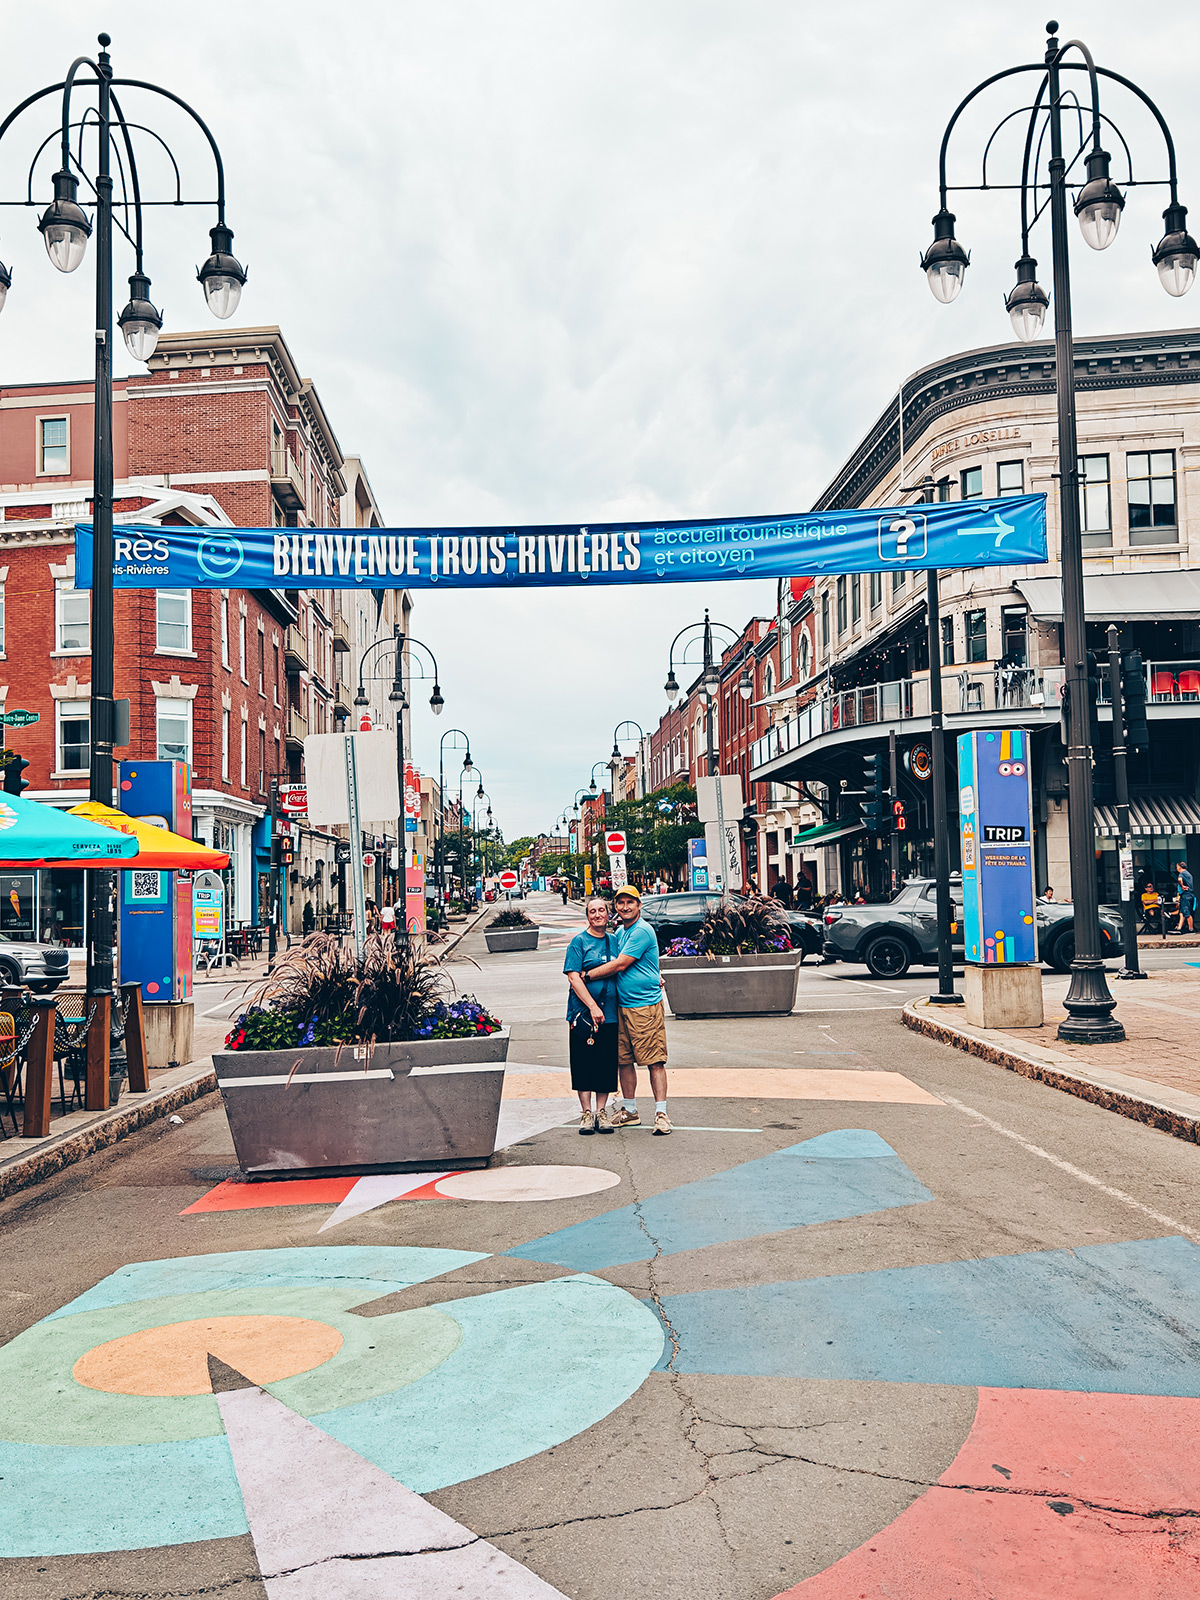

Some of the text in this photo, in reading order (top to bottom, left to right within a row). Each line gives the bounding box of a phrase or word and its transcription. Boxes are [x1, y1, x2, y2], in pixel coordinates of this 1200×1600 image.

[964, 427, 1022, 447] LOISELLE
[654, 522, 848, 545] accueil touristique
[273, 528, 641, 576] BIENVENUE TROIS-RIVIÈRES
[654, 547, 755, 567] et citoyen
[112, 563, 170, 575] is-Rivières
[986, 827, 1022, 841] TRIP
[197, 892, 211, 900] TRIP
